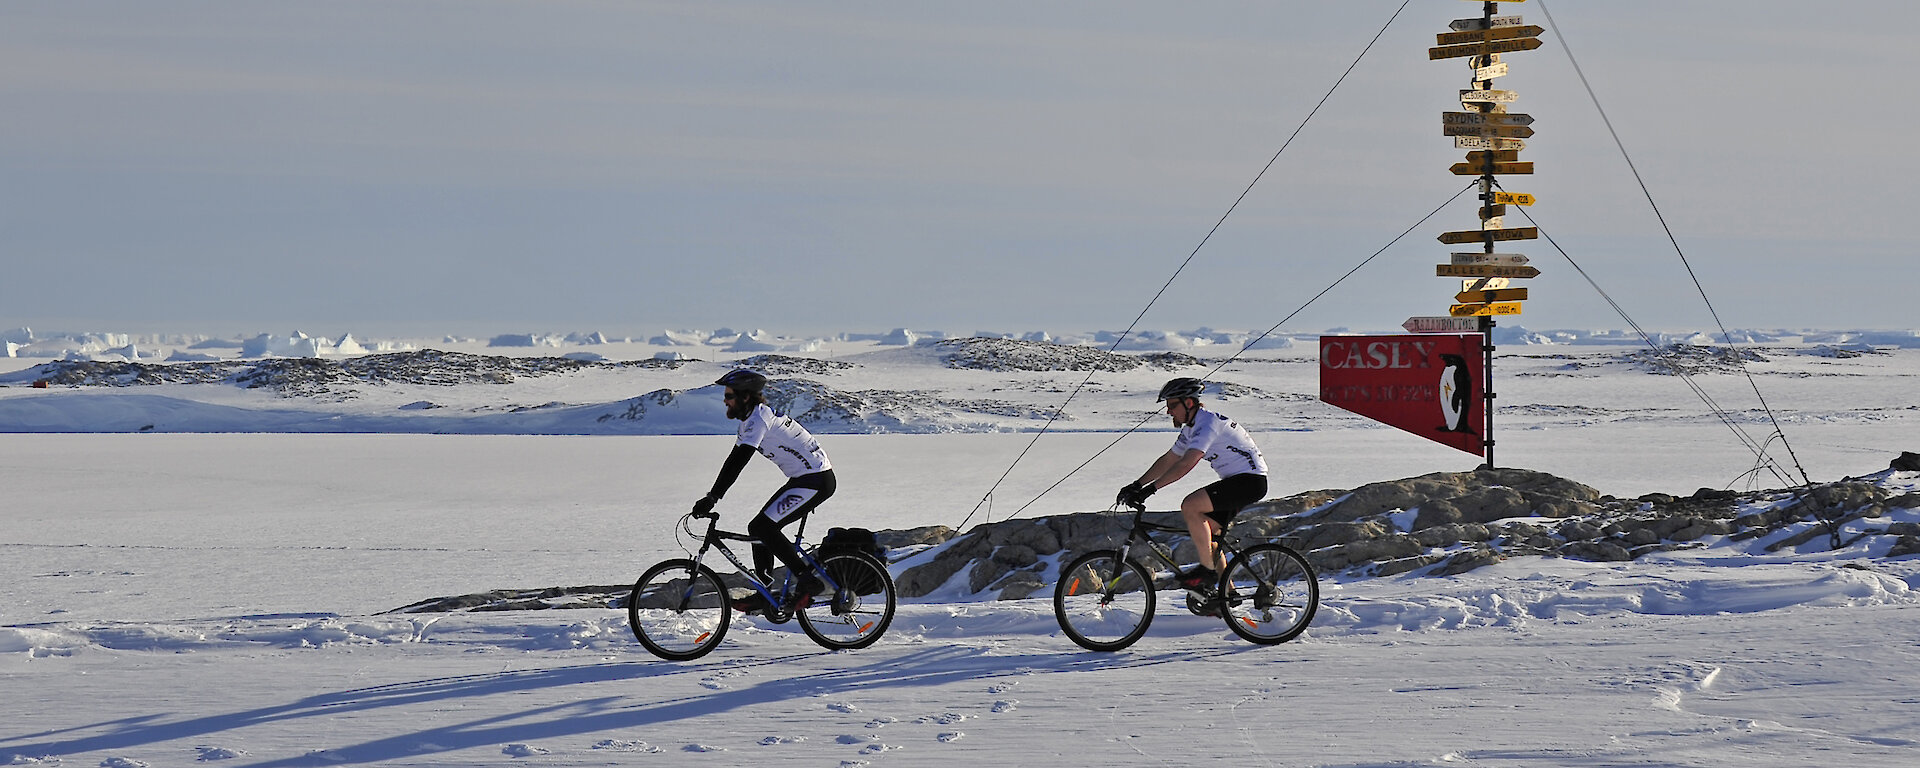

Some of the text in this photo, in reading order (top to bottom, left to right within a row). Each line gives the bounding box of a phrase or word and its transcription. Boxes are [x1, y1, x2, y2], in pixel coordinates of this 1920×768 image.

[1443, 31, 1486, 42] BRISBANE
[1448, 45, 1482, 57] DUMONT
[1446, 114, 1487, 124] SYDNEY
[1446, 127, 1482, 136] MACQUARIE
[1460, 138, 1491, 148] ADELAIDE
[1438, 265, 1485, 275] HALLEY
[1495, 267, 1516, 276] BAY
